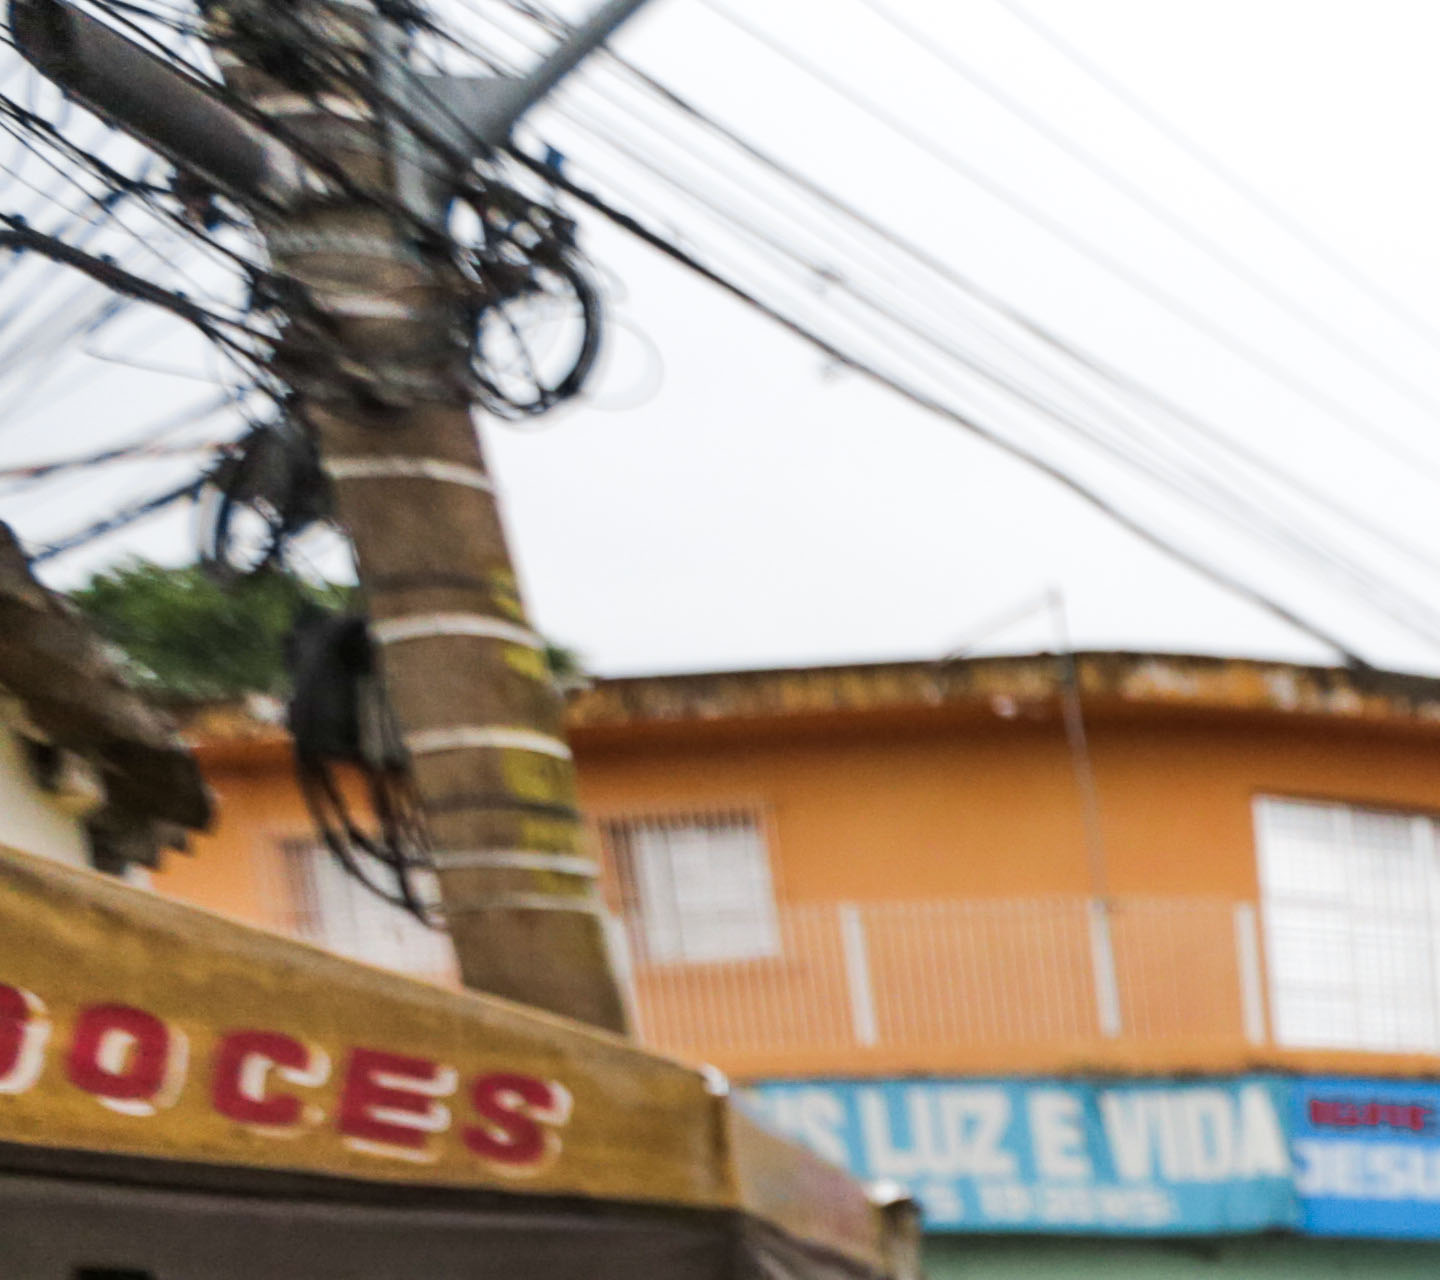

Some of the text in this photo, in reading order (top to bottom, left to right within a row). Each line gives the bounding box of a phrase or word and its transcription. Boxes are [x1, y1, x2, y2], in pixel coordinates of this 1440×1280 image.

[854, 1086, 1018, 1178] LUZ
[1026, 1087, 1094, 1182] E
[1103, 1082, 1293, 1183] VIDA
